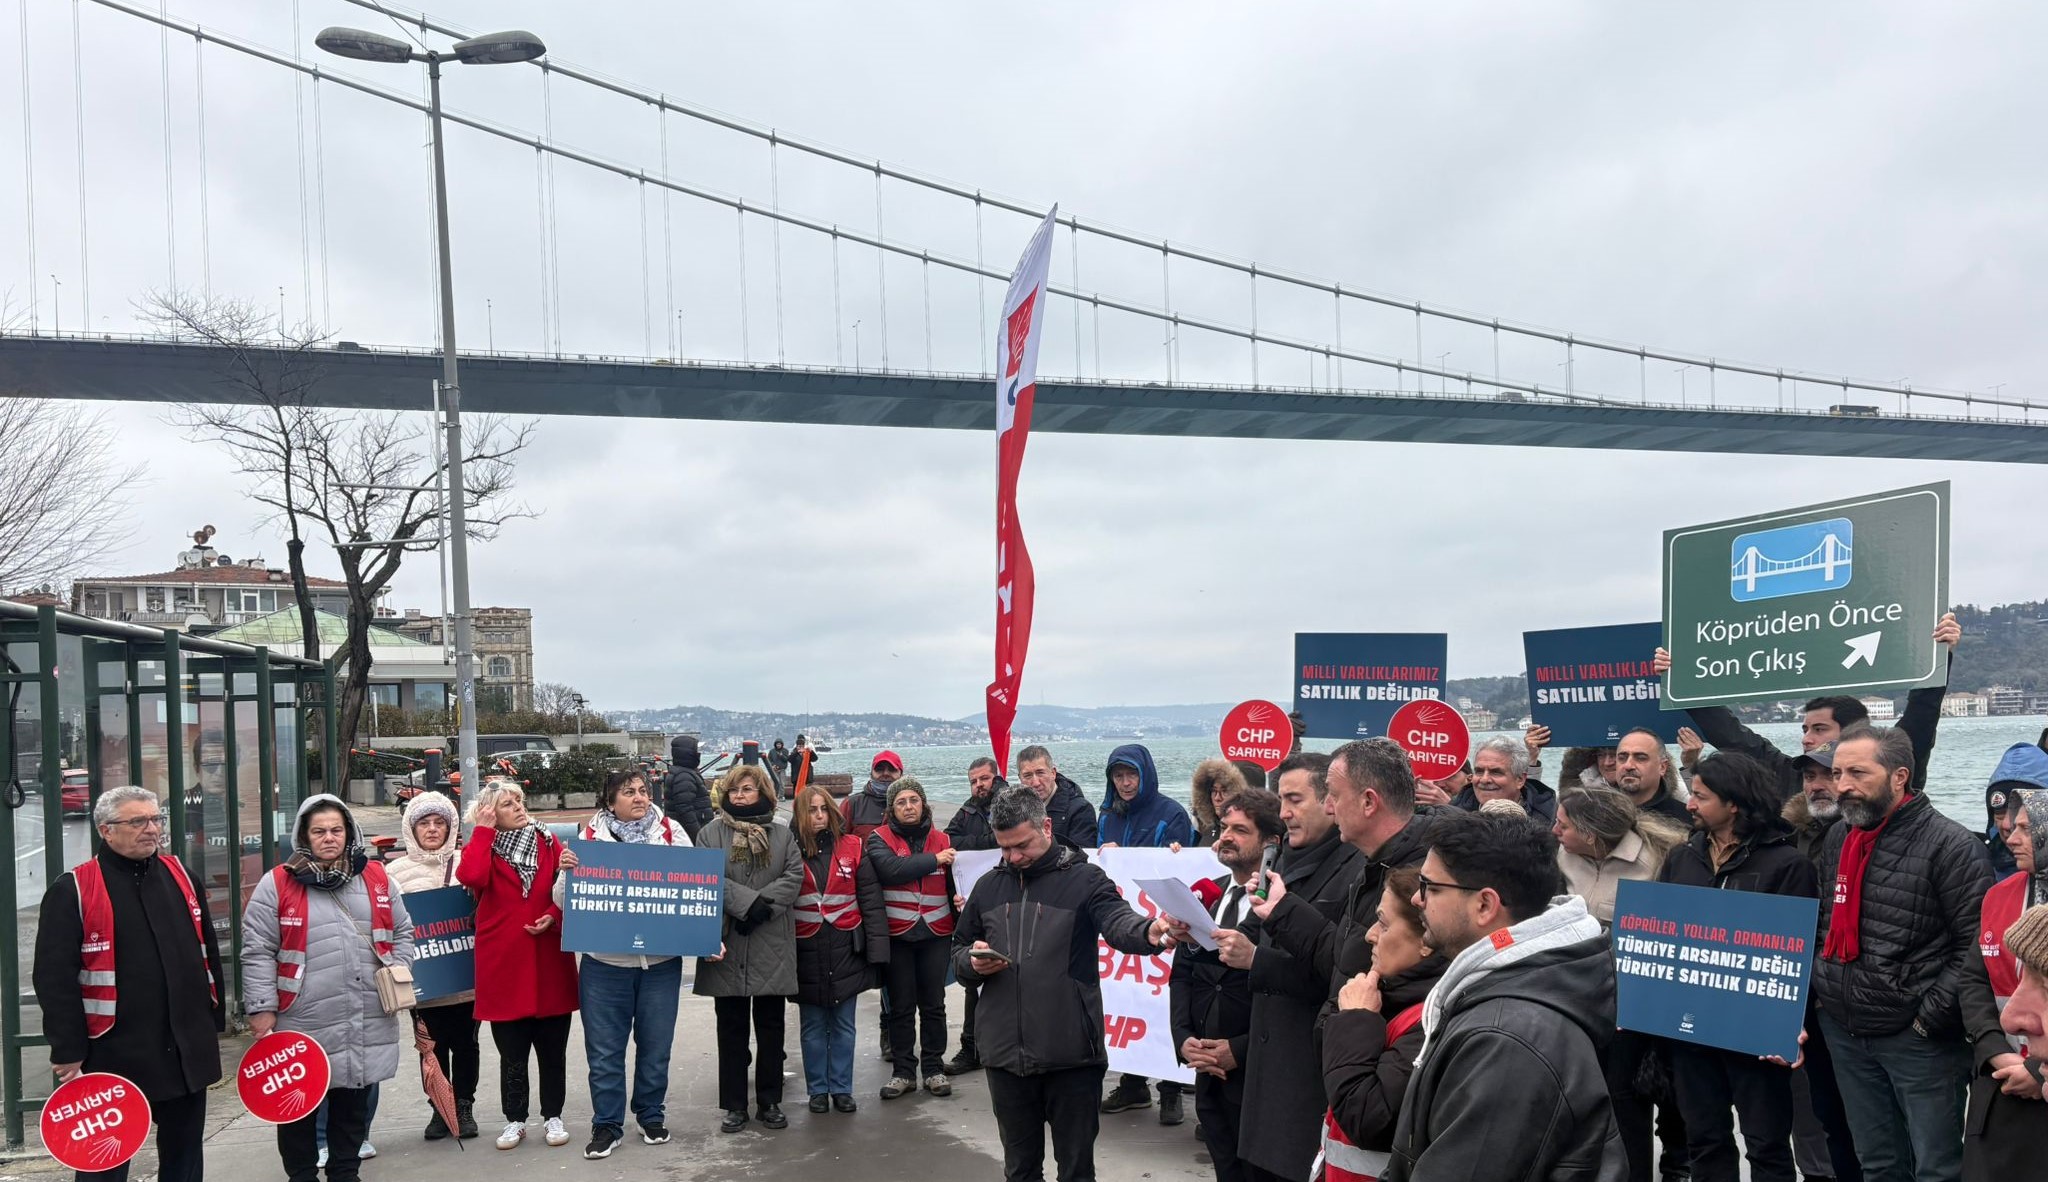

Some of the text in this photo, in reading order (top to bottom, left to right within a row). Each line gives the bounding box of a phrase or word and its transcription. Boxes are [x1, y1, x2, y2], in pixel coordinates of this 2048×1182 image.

[1696, 600, 1903, 646] Köprüden Önce
[1340, 665, 1440, 682] VARLIKLARIMIZ
[1695, 648, 1807, 681] Son Çıkış
[1300, 682, 1440, 702] SATILIK DEĞİLDİR
[1536, 686, 1607, 704] SATILIK
[1237, 728, 1275, 743] CHP
[1407, 730, 1449, 748] CHP
[1228, 746, 1281, 760] SARIYER
[1408, 751, 1457, 766] ARIYER
[573, 865, 718, 885] KÖPRÜLER, YOLLAR, ORMANLAR
[572, 881, 718, 901] TÜRKİYE ARSANIZ DEĞİL!
[571, 897, 717, 917] TÜRKİYE SATILIK DEĞİL!
[414, 917, 472, 939] KLARIMIZ
[1620, 914, 1805, 953] KÖPRÜLER, YOLLAR, ORMANLAR
[1617, 935, 1801, 978] TÜRKİYE ARSANIZ DEĞİL!
[1616, 956, 1799, 1001] TÜRKİYE SATILIK DEĞİL!
[1104, 1014, 1147, 1049] HP
[244, 1039, 308, 1079] SARIYER
[262, 1062, 306, 1096] CHP
[49, 1084, 126, 1122] SARIYER
[71, 1107, 123, 1141] CHP
